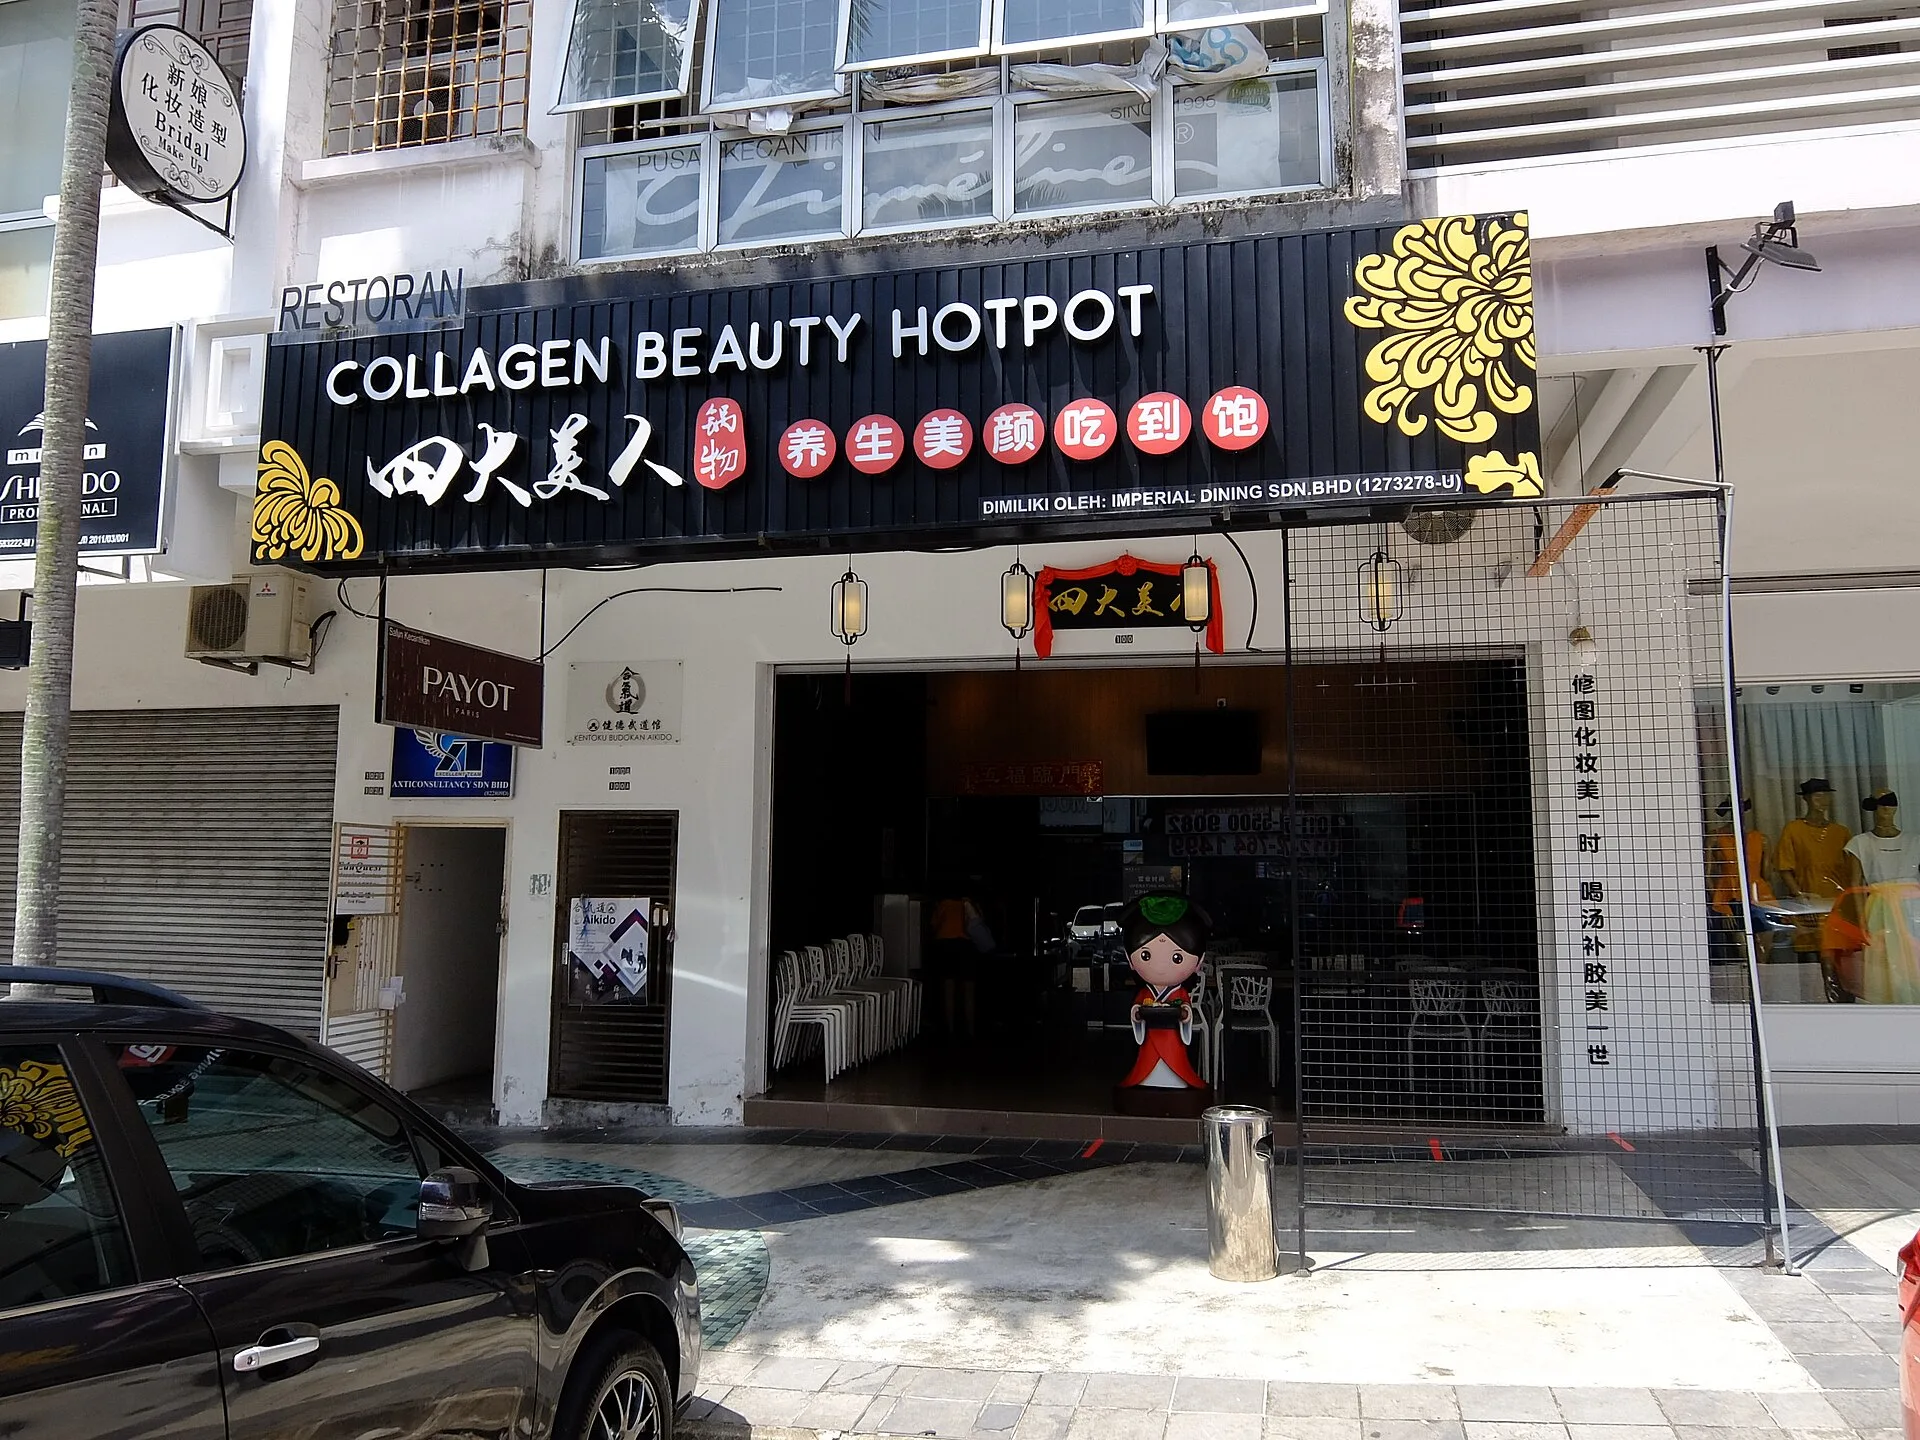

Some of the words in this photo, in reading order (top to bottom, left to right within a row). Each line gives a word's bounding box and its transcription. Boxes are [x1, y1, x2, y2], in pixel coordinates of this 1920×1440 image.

[168, 61, 208, 109] 新娘
[141, 72, 228, 149] 化妆造型
[1110, 101, 1151, 120] SINC
[154, 109, 209, 162] Bridal
[158, 135, 184, 161] Make
[190, 157, 204, 175] Up
[637, 149, 702, 174] PUSA
[723, 122, 882, 164] KECANTIKN
[279, 268, 463, 331] RESTORAN
[326, 336, 610, 405] COLLAGEN
[635, 313, 861, 380] BEAUTY
[892, 284, 1154, 358] HOTPOT
[701, 402, 737, 479] 锅物
[786, 394, 1259, 469] 养生美颜吃到饱
[367, 413, 684, 507] 四大美人
[0, 470, 121, 500] SHIDO
[983, 498, 1050, 515] DIMILIKI
[1053, 494, 1107, 511] OLEH:
[1111, 489, 1196, 508] IMPERIAL
[1200, 484, 1263, 503] DINING
[1268, 478, 1352, 499] SDN.BHD
[1355, 473, 1462, 495] (1273278-U)
[1115, 635, 1134, 644] 100
[422, 666, 515, 712] PAYOT
[455, 708, 480, 719] PARIS
[574, 733, 608, 742] KENTOKU
[608, 733, 646, 742] BUDOKAN
[646, 733, 673, 741] AIKIDO
[392, 780, 470, 789] AXTICONSULTANCY
[472, 781, 490, 789] SDN
[491, 781, 509, 789] BHD
[1572, 674, 1601, 854] 修图化妆美一时
[583, 914, 616, 925] Aikido
[1581, 880, 1609, 1067] 喝汤补胶美一世
